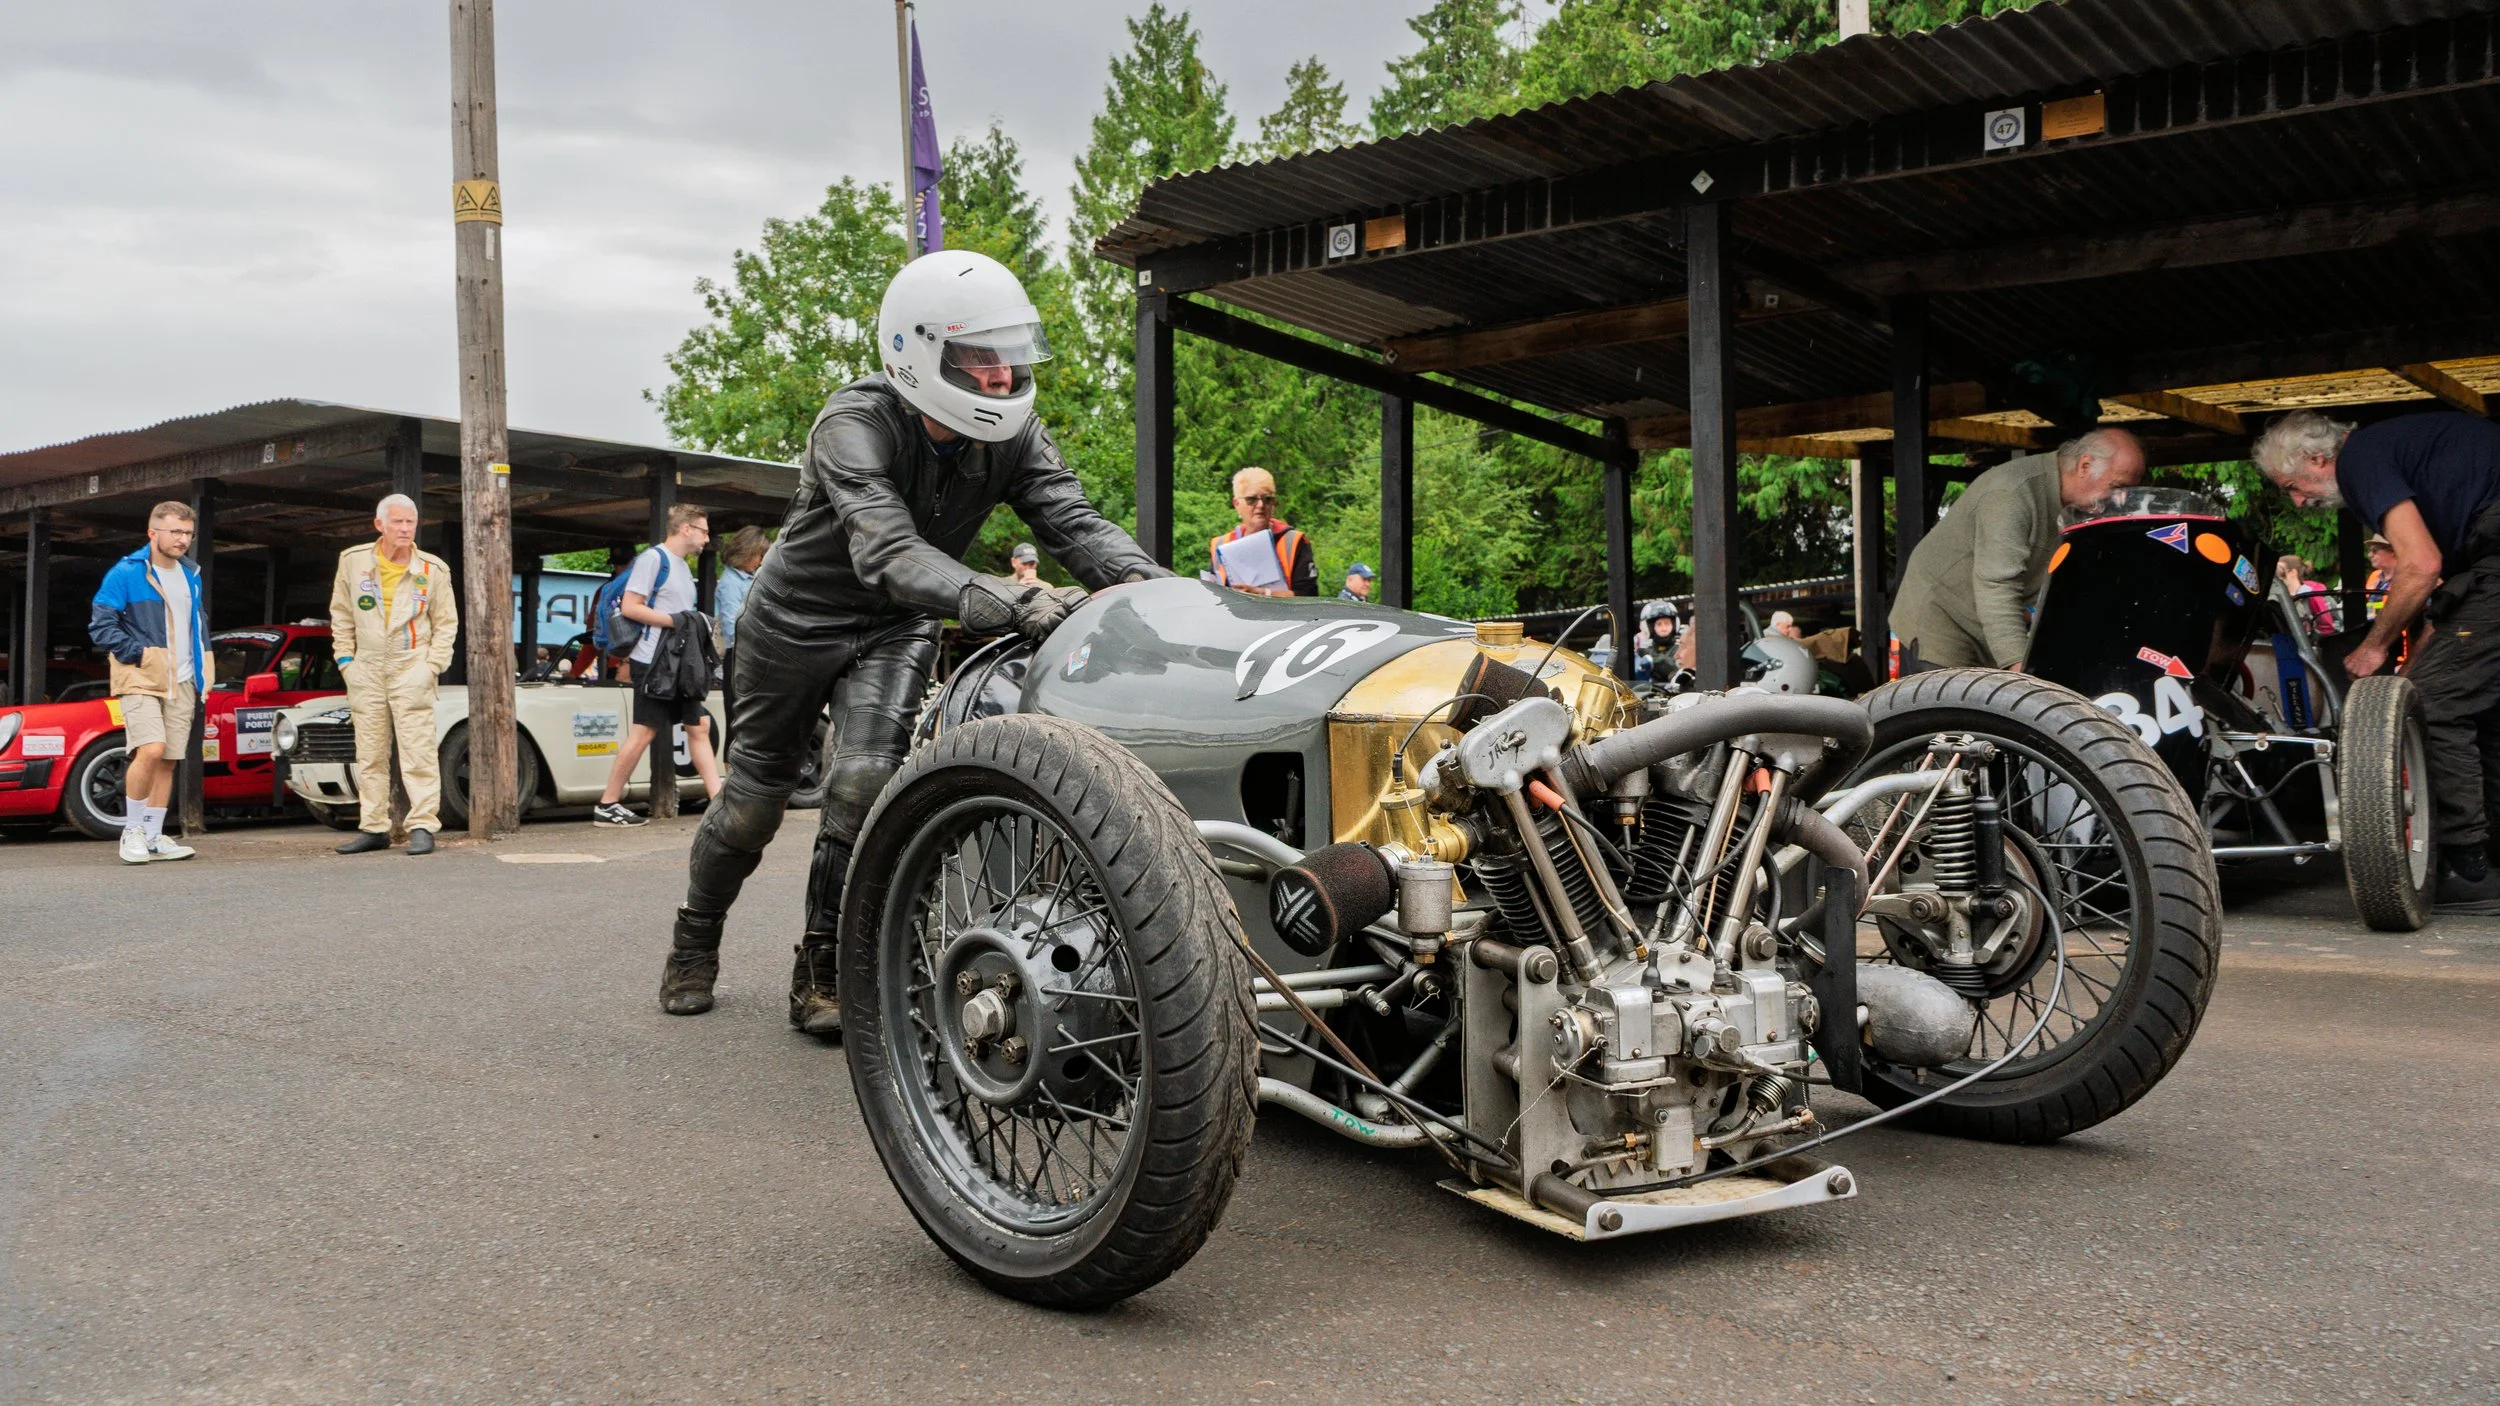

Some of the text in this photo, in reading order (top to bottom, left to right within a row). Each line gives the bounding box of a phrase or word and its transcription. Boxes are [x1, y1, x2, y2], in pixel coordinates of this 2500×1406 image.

[1997, 123, 2013, 135] 47
[947, 324, 964, 332] BELL
[1235, 618, 1380, 701] 16
[2142, 650, 2171, 668] TOW
[1331, 1107, 1377, 1135] TOW
